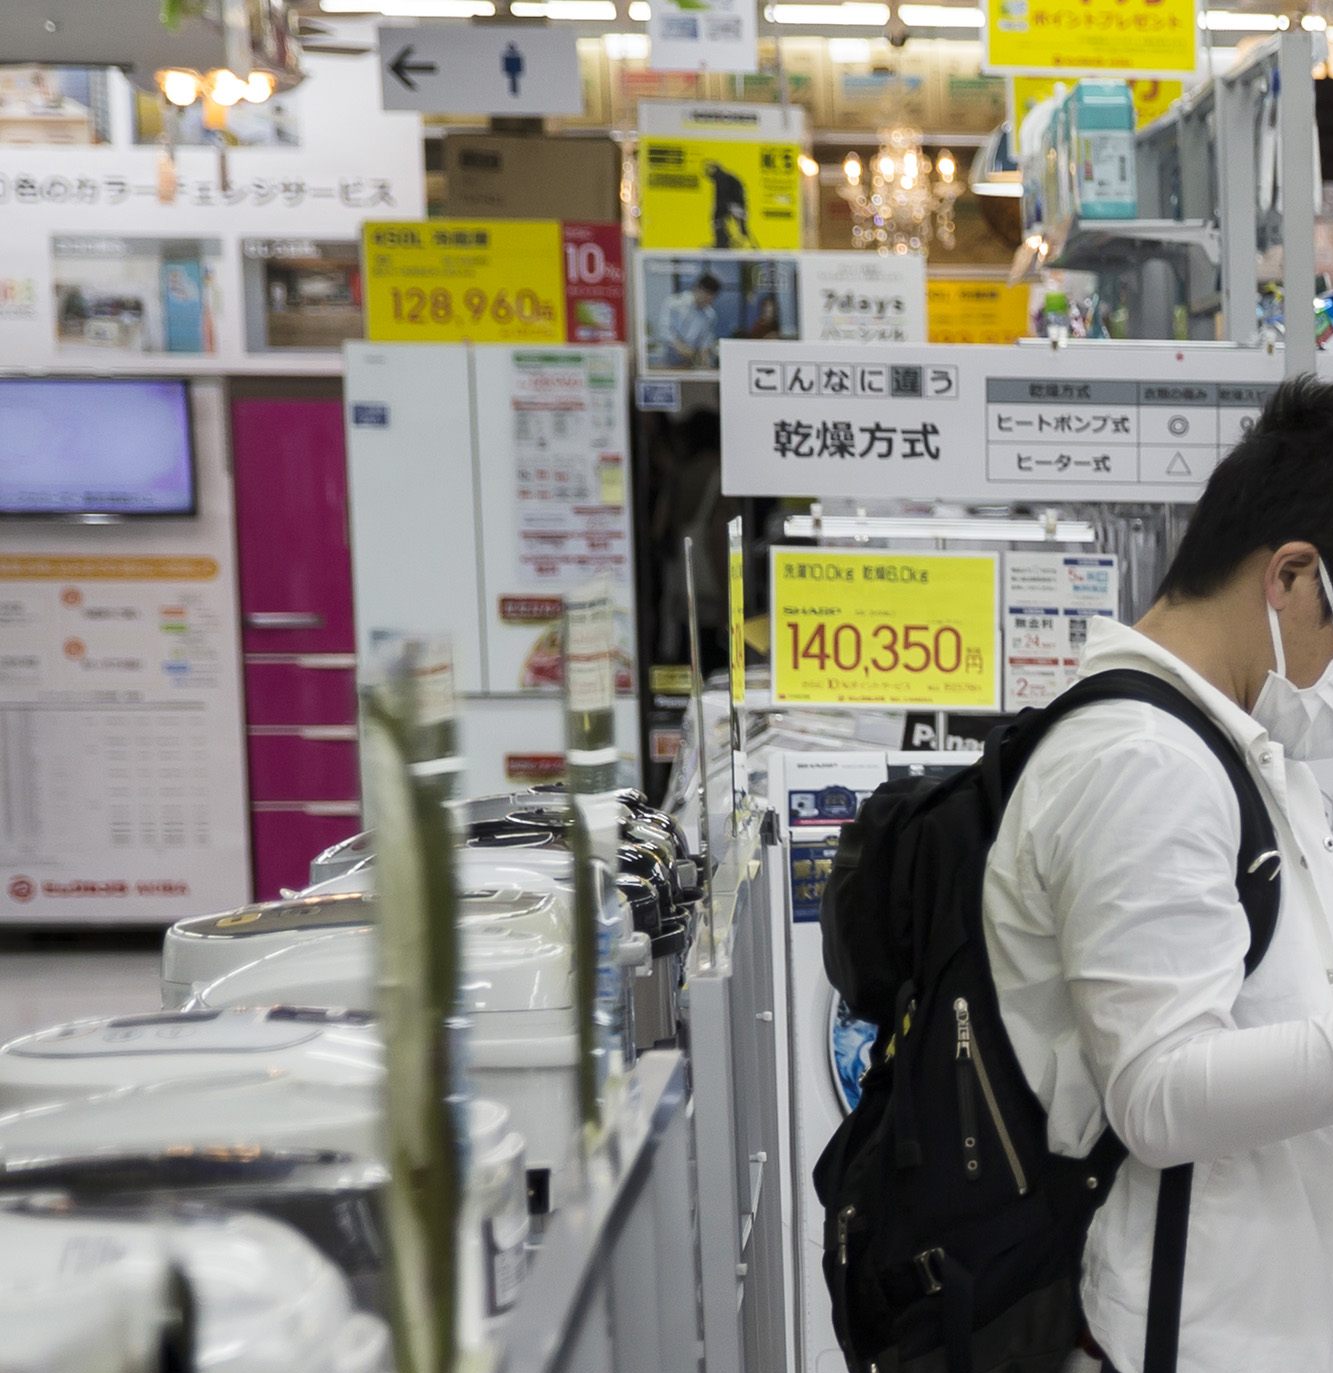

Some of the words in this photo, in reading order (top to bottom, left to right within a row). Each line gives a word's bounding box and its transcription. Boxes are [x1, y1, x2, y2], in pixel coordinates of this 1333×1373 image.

[754, 366, 953, 395] こんなに違う
[996, 413, 1131, 434] ヒートポンプ式
[773, 420, 941, 460] 乾燥方式
[1016, 453, 1111, 473] ヒーター式
[786, 621, 962, 678] 140,350
